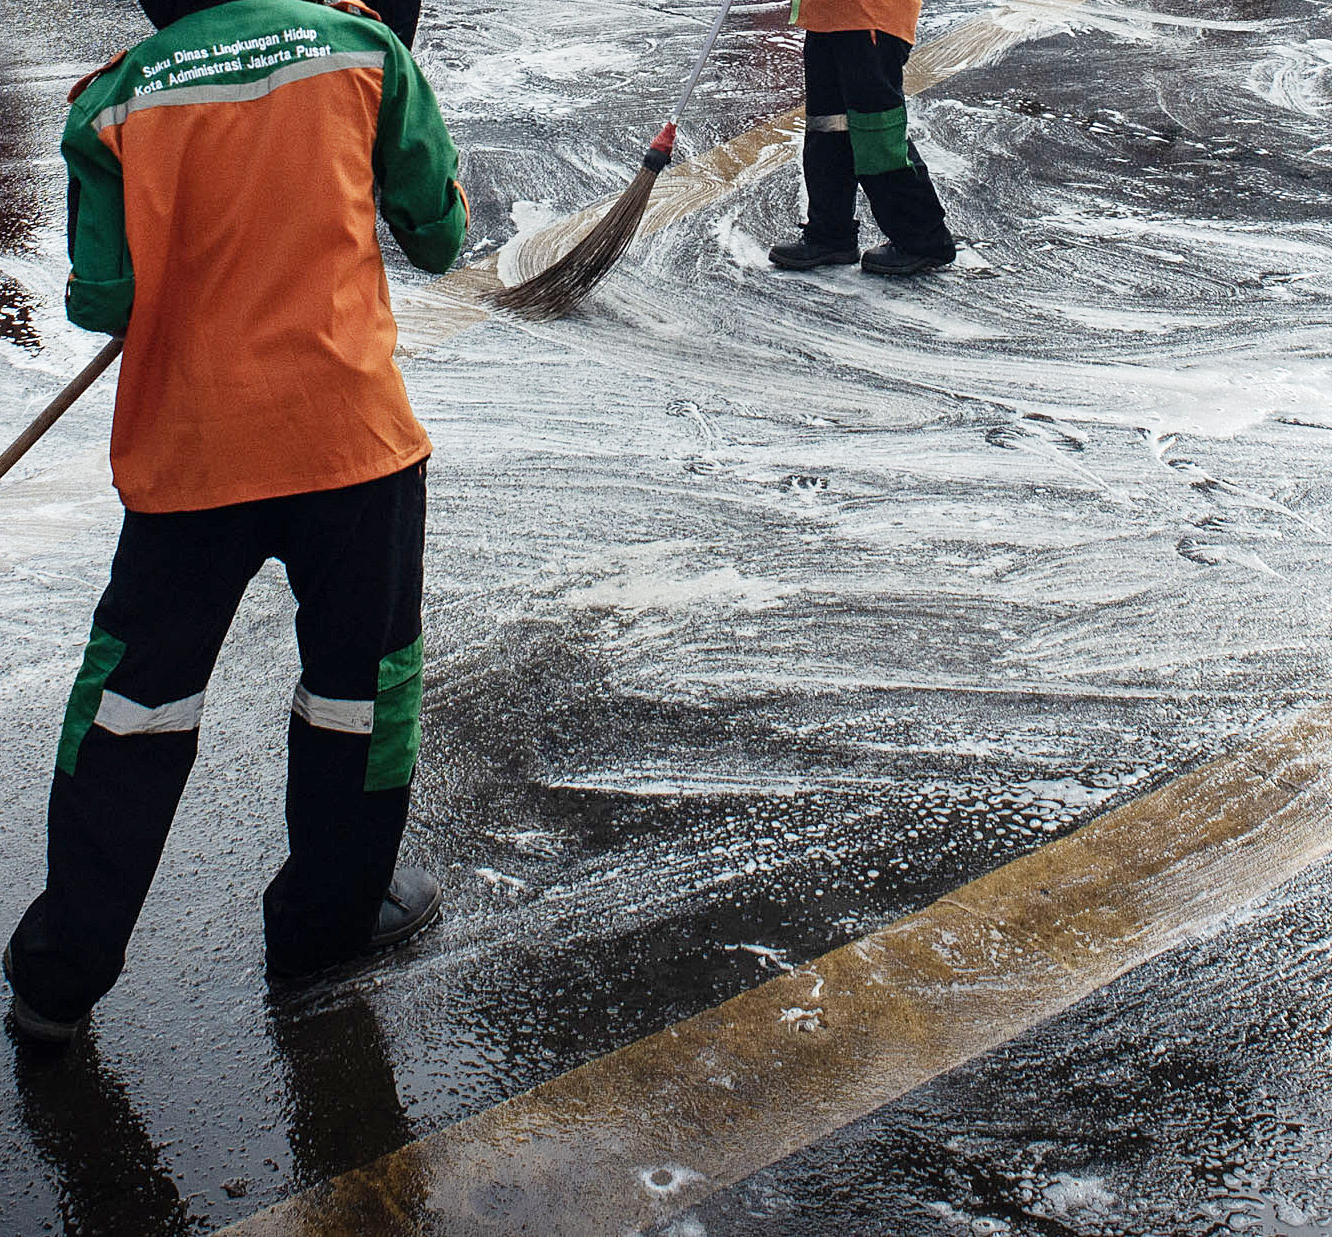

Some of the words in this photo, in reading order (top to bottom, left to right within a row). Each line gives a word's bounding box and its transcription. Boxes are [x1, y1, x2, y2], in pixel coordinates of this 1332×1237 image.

[134, 78, 164, 98] Kota
[168, 57, 242, 86] Administrasi
[246, 47, 292, 69] Jakarta
[296, 44, 332, 59] Pusat
[142, 58, 170, 79] Suku
[174, 47, 209, 64] Dinas
[213, 33, 280, 58] Lingkungan
[283, 27, 318, 43] Hidup
